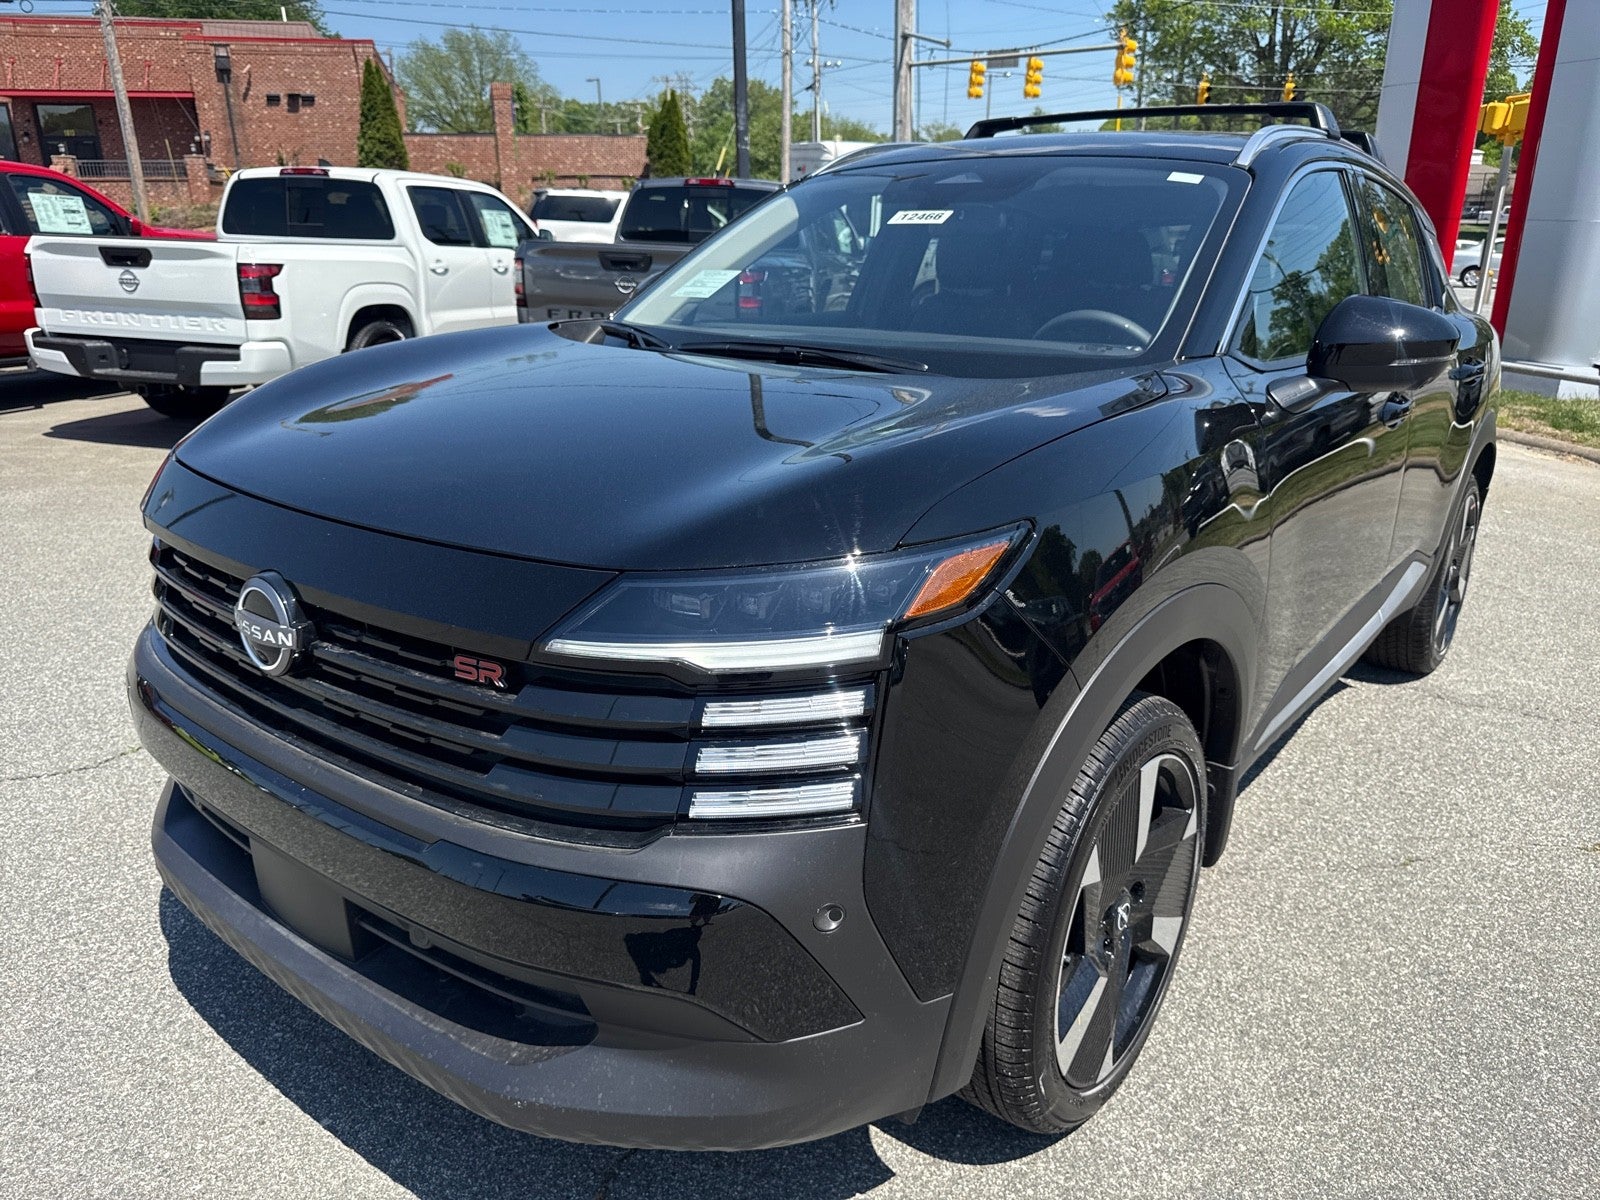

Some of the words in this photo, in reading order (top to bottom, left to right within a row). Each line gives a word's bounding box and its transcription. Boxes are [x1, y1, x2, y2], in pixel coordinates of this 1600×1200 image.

[900, 212, 945, 221] 12466
[59, 309, 228, 332] FRONTIER
[237, 616, 293, 647] SSAN
[453, 655, 505, 688] SR
[1114, 723, 1173, 784] BRIDGESTONE
